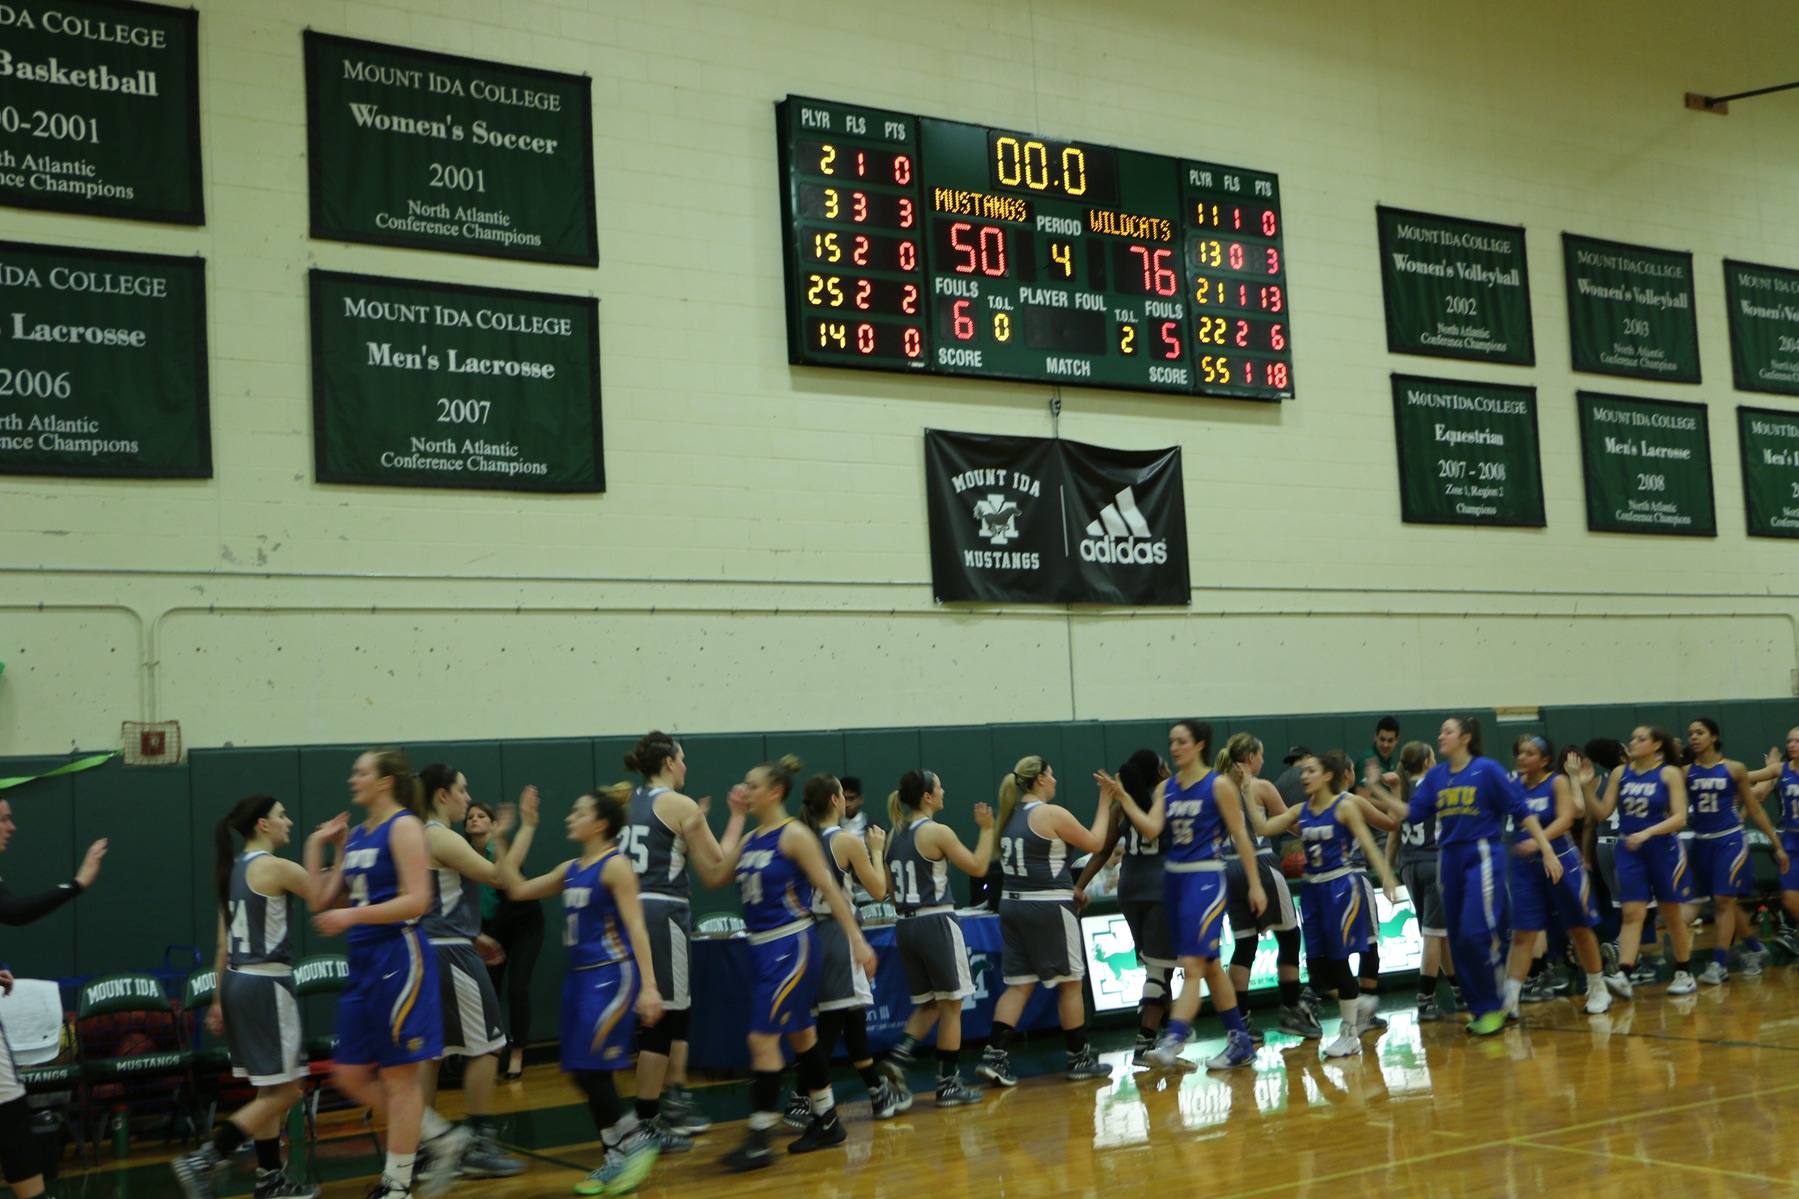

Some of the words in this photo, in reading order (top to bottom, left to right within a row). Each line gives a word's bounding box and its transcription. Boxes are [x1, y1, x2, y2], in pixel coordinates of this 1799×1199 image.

[42, 11, 167, 49] COLLEGE
[343, 60, 423, 90] MOUNT
[427, 72, 466, 97] IDA
[470, 80, 561, 112] COLLEGE
[0, 105, 100, 144] 0-2001
[349, 102, 464, 141] Women's
[472, 120, 558, 154] Soccer
[801, 108, 830, 129] PLYR
[846, 115, 866, 135] FLS
[884, 121, 906, 141] PTS
[21, 153, 96, 177] Atlantic
[429, 163, 486, 193] 2001
[819, 144, 836, 176] 2
[857, 152, 865, 177] 1
[893, 155, 911, 185] 0
[996, 136, 1086, 196] 00.0
[30, 173, 134, 200] Champions
[1189, 169, 1213, 188] PLYR
[1224, 175, 1241, 192] FLS
[1255, 179, 1273, 197] PTS
[408, 200, 449, 219] North
[455, 206, 511, 227] Atlantic
[823, 188, 839, 219] 3
[852, 192, 867, 223] 3
[898, 198, 913, 229] 3
[934, 187, 1027, 223] MUSTANGS
[1197, 202, 1219, 227] 11
[1233, 207, 1240, 230] 1
[1261, 210, 1277, 237] 0
[375, 213, 459, 237] Conference
[462, 222, 542, 246] Champions
[1036, 214, 1082, 236] PERIOD
[1089, 208, 1171, 242] WILDCATS
[1396, 224, 1439, 244] MOUNT
[1440, 230, 1461, 247] IDA
[1462, 233, 1512, 254] COLLEGE
[815, 232, 841, 263] 15
[853, 235, 869, 266] 2
[898, 240, 916, 271] 0
[950, 222, 1006, 277] 50
[1051, 243, 1072, 277] 4
[1200, 240, 1222, 267] 13
[1229, 243, 1244, 270] 0
[1266, 248, 1279, 275] 3
[50, 267, 167, 298] COLLEGE
[1129, 245, 1176, 297] 76
[1392, 252, 1455, 278] Women's
[1455, 261, 1520, 288] Volleyball
[807, 274, 844, 307] 25
[855, 279, 871, 310] 2
[902, 284, 917, 315] 2
[935, 277, 979, 298] FOULS
[1019, 286, 1068, 308] PLAYER
[1075, 292, 1107, 312] FOUL
[1196, 277, 1225, 304] 21
[1239, 284, 1246, 307] 1
[1260, 286, 1282, 312] 13
[1577, 278, 1631, 302] Women's
[1633, 285, 1688, 310] Volleyball
[343, 297, 430, 324] MOUNT
[435, 305, 473, 328] IDA
[476, 309, 572, 336] COLLEGE
[952, 300, 975, 340] 6
[1145, 300, 1183, 320] FOULS
[1445, 295, 1478, 316] 2002
[11, 312, 147, 347] Lacrosse
[819, 322, 846, 349] 14
[857, 323, 874, 354] 0
[904, 327, 921, 358] 0
[993, 312, 1011, 342] 0
[1120, 325, 1135, 354] 2
[1161, 321, 1181, 359] 5
[1199, 316, 1227, 345] 22
[1235, 320, 1249, 347] 2
[1270, 323, 1285, 351] 6
[366, 342, 440, 371] Men's
[447, 349, 556, 379] Lacrosse
[938, 347, 983, 368] SCORE
[1046, 357, 1091, 377] MATCH
[1201, 355, 1231, 384] 55
[1245, 361, 1252, 384] 1
[1266, 361, 1288, 389] 18
[0, 368, 71, 399] 2006
[1149, 366, 1188, 385] SCORE
[437, 398, 491, 425] 2007
[1407, 390, 1450, 408] MOUNT
[1452, 395, 1474, 410] IDA
[1474, 396, 1527, 415] COLLEGE
[27, 414, 99, 433] Atlantic
[1593, 406, 1632, 424] MOUNT
[1651, 413, 1696, 431] COLLEGE
[38, 433, 139, 456] Champions
[410, 436, 456, 454] North
[461, 438, 519, 457] Atlantic
[1434, 423, 1504, 447] Equestrian
[1605, 436, 1637, 456] Men's
[1641, 440, 1691, 460] Lacrosse
[380, 452, 463, 471] Conference
[467, 456, 548, 476] Champions
[951, 467, 1008, 494] MOUNT
[1012, 471, 1041, 498] IDA
[964, 549, 1040, 570] MUSTANGS
[1079, 536, 1168, 566] adidas
[1622, 797, 1649, 819] 22
[1698, 793, 1719, 813] 21
[1000, 837, 1028, 877] 21
[890, 859, 921, 904] 31
[293, 960, 335, 986] MOUNT
[87, 977, 134, 1006] MOUNT
[134, 977, 160, 998] IDA
[116, 1055, 181, 1072] MUSTANGS
